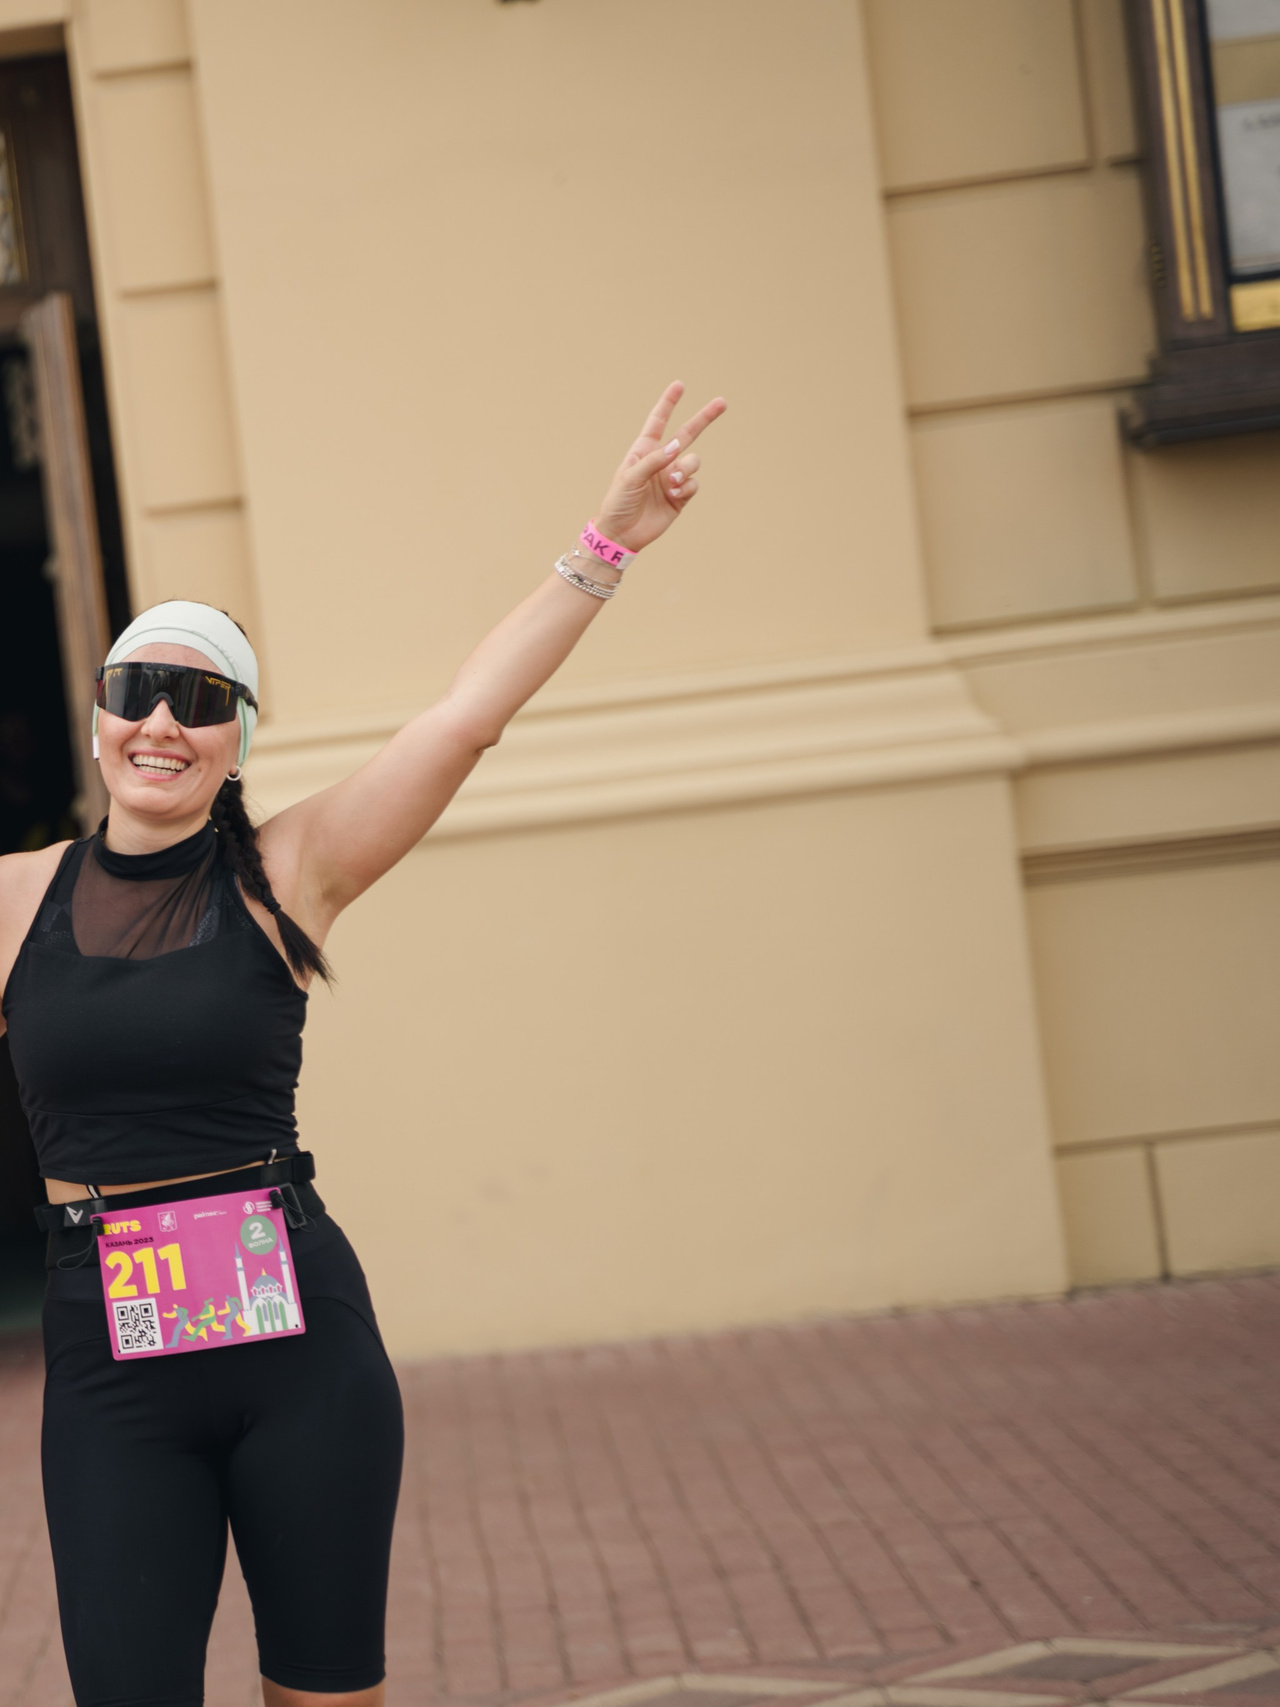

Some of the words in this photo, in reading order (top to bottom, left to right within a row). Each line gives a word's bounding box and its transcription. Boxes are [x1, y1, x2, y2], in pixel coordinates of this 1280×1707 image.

[205, 675, 231, 707] VIPER
[103, 1220, 142, 1235] RUTS
[249, 1222, 266, 1240] 2
[105, 1239, 133, 1248] КАЗАНЬ
[133, 1236, 154, 1245] 2023
[248, 1237, 273, 1249] ВОЛНА
[105, 1243, 187, 1299] 211
